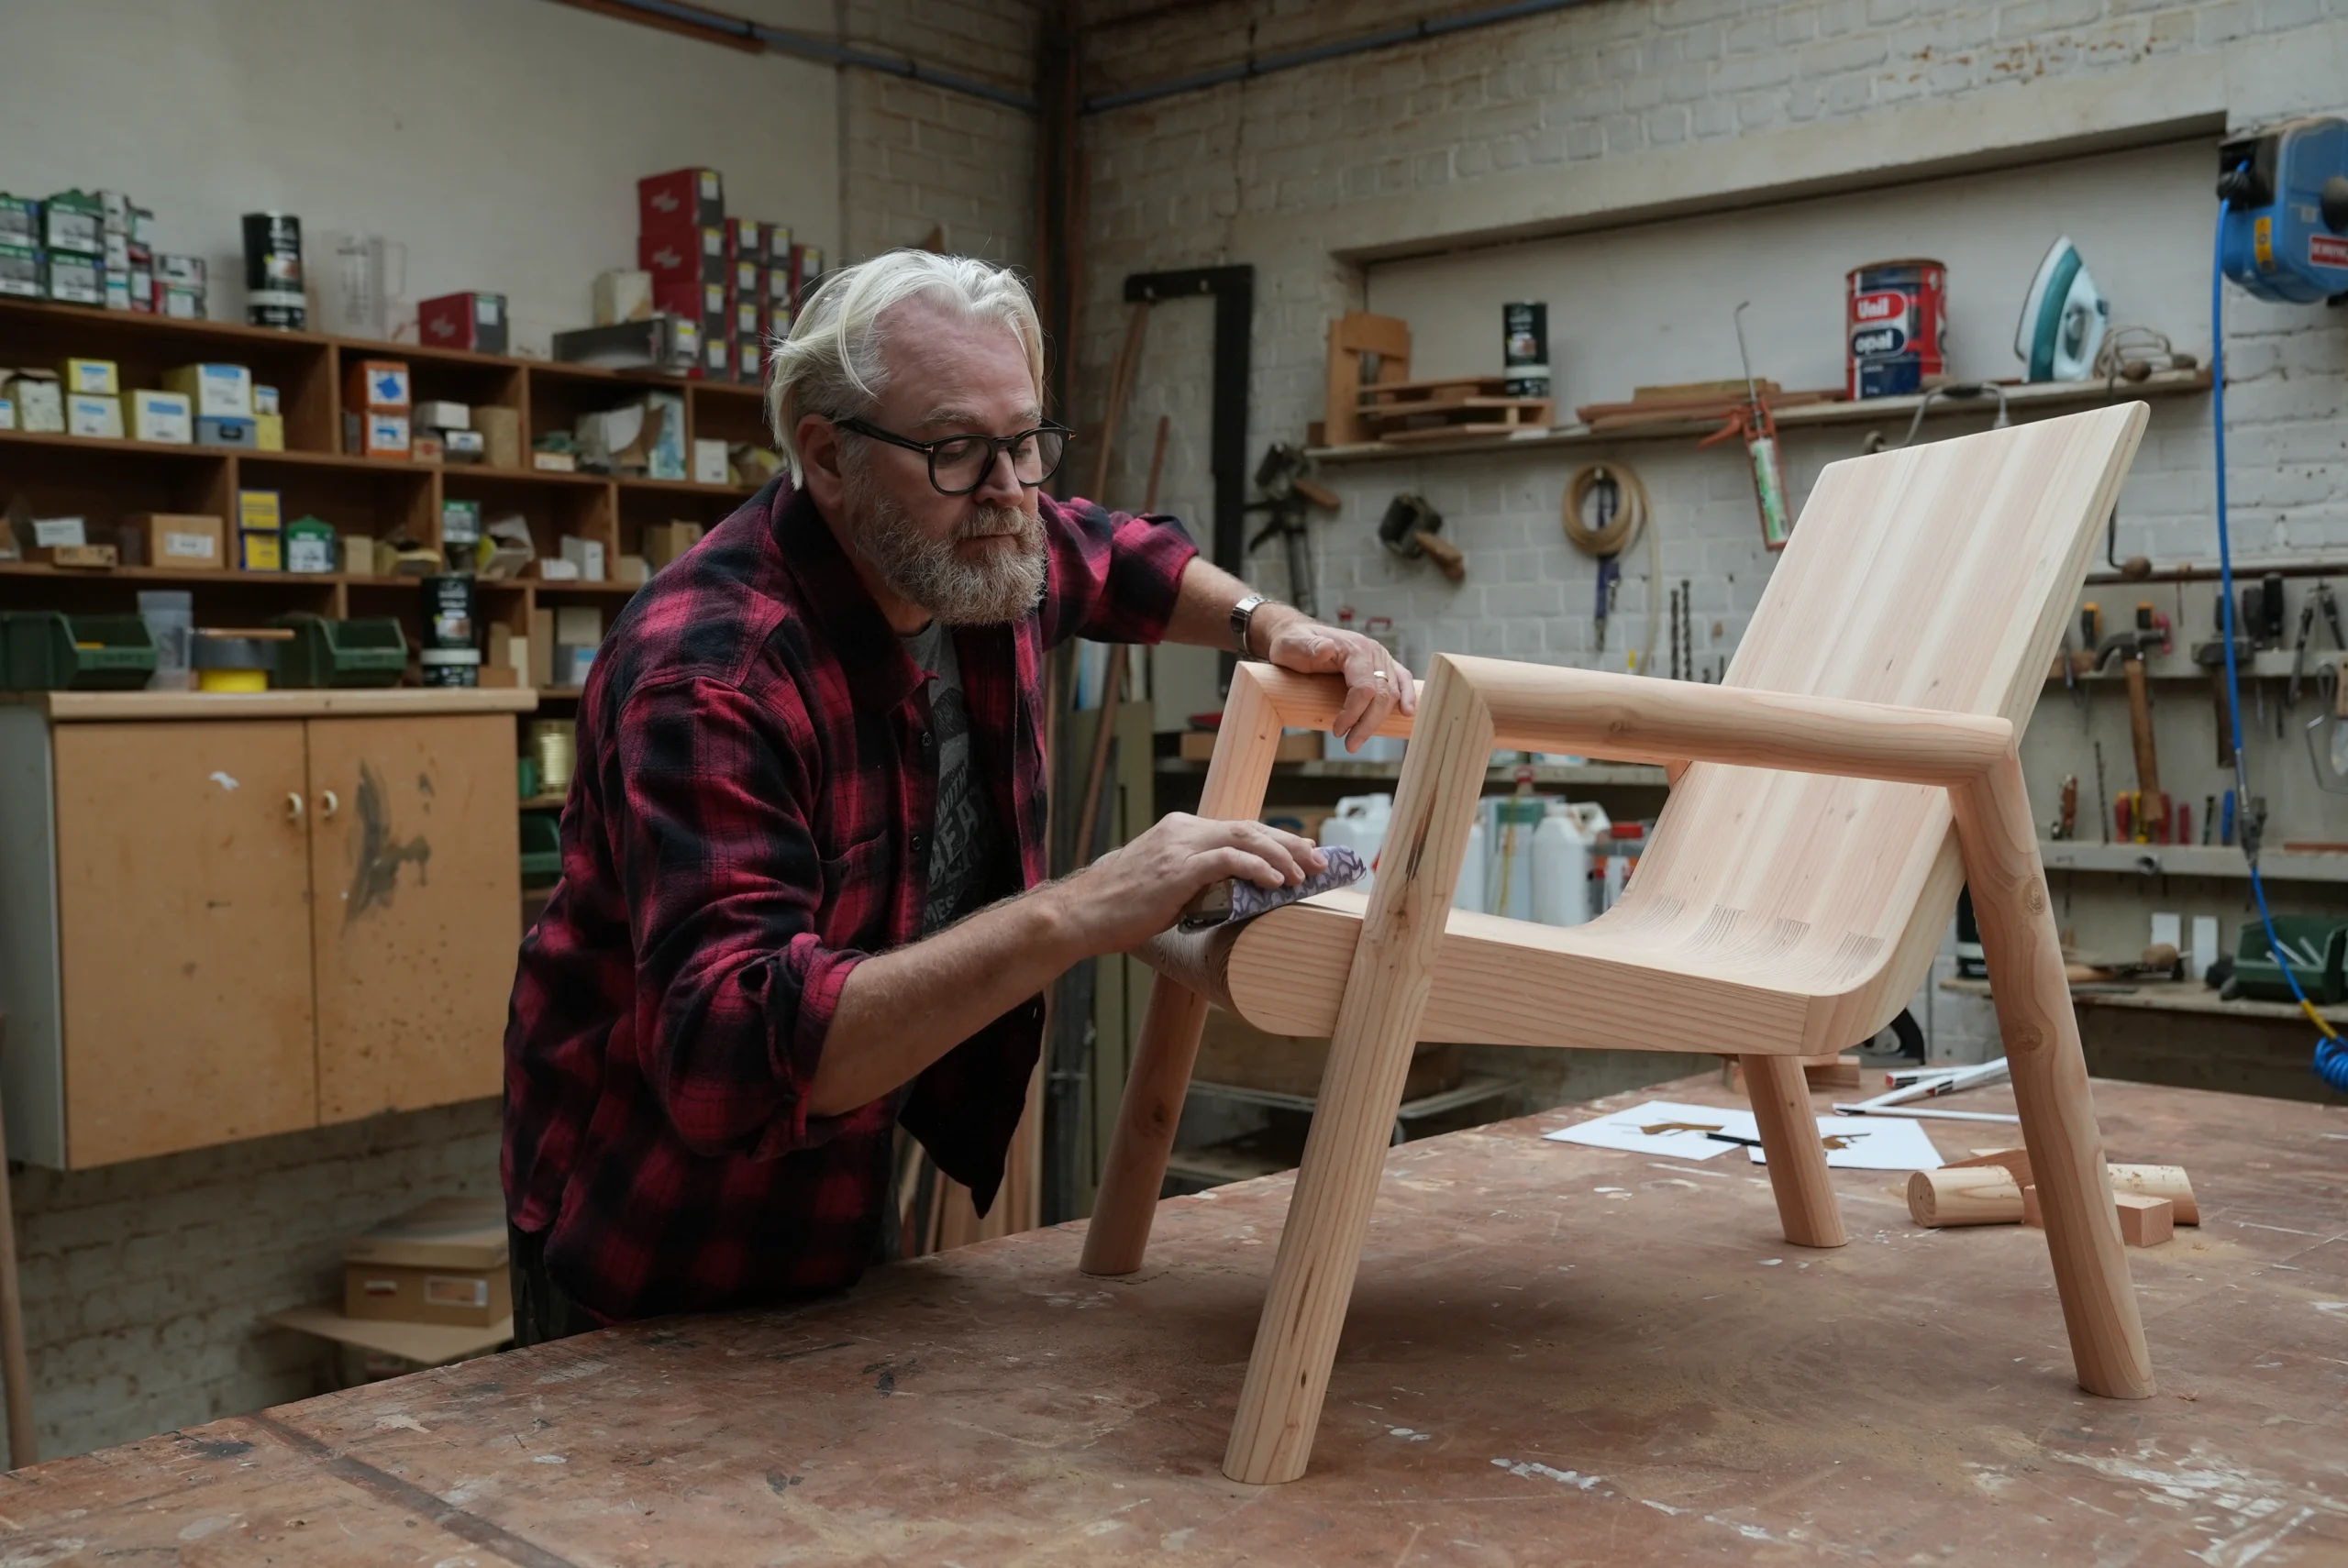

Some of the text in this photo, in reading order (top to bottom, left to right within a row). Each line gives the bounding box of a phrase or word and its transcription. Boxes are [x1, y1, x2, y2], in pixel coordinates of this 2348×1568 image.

[1858, 297, 1889, 319] Unil
[1855, 329, 1893, 355] opal
[936, 765, 968, 827] WITH
